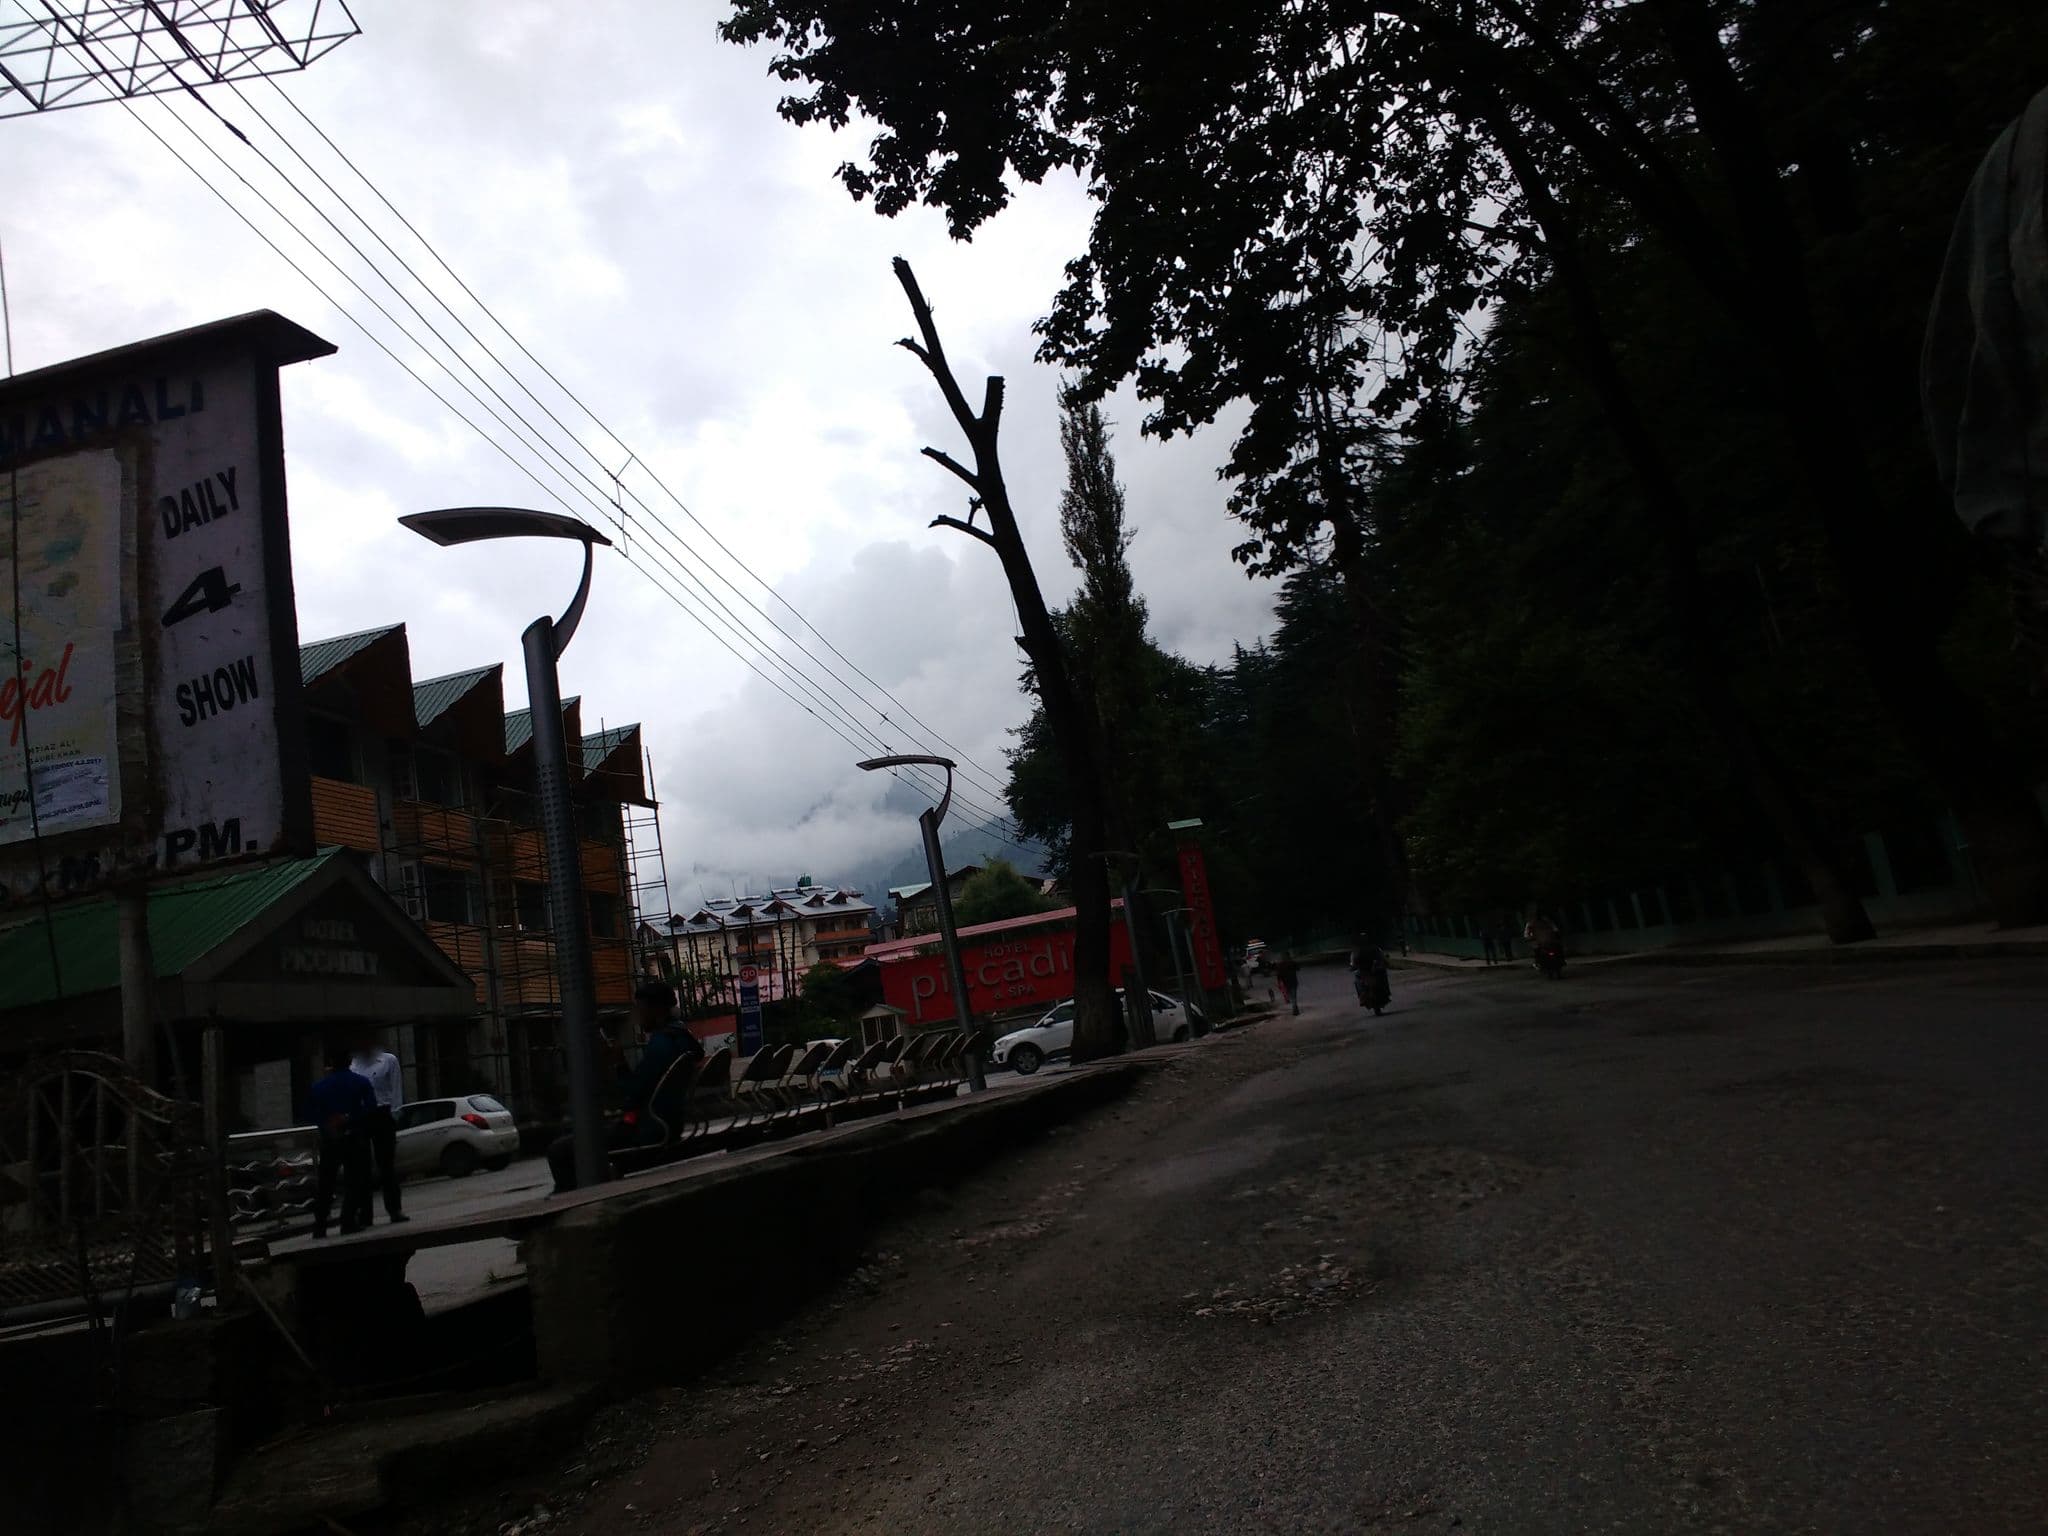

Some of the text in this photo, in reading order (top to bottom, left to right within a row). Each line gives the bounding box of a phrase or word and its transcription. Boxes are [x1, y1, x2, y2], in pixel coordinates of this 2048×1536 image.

[161, 467, 241, 540] DAILY
[161, 566, 241, 627] 4
[177, 655, 257, 728] SHOW
[984, 943, 1032, 958] HOTEL
[1007, 983, 1037, 997] SPA
